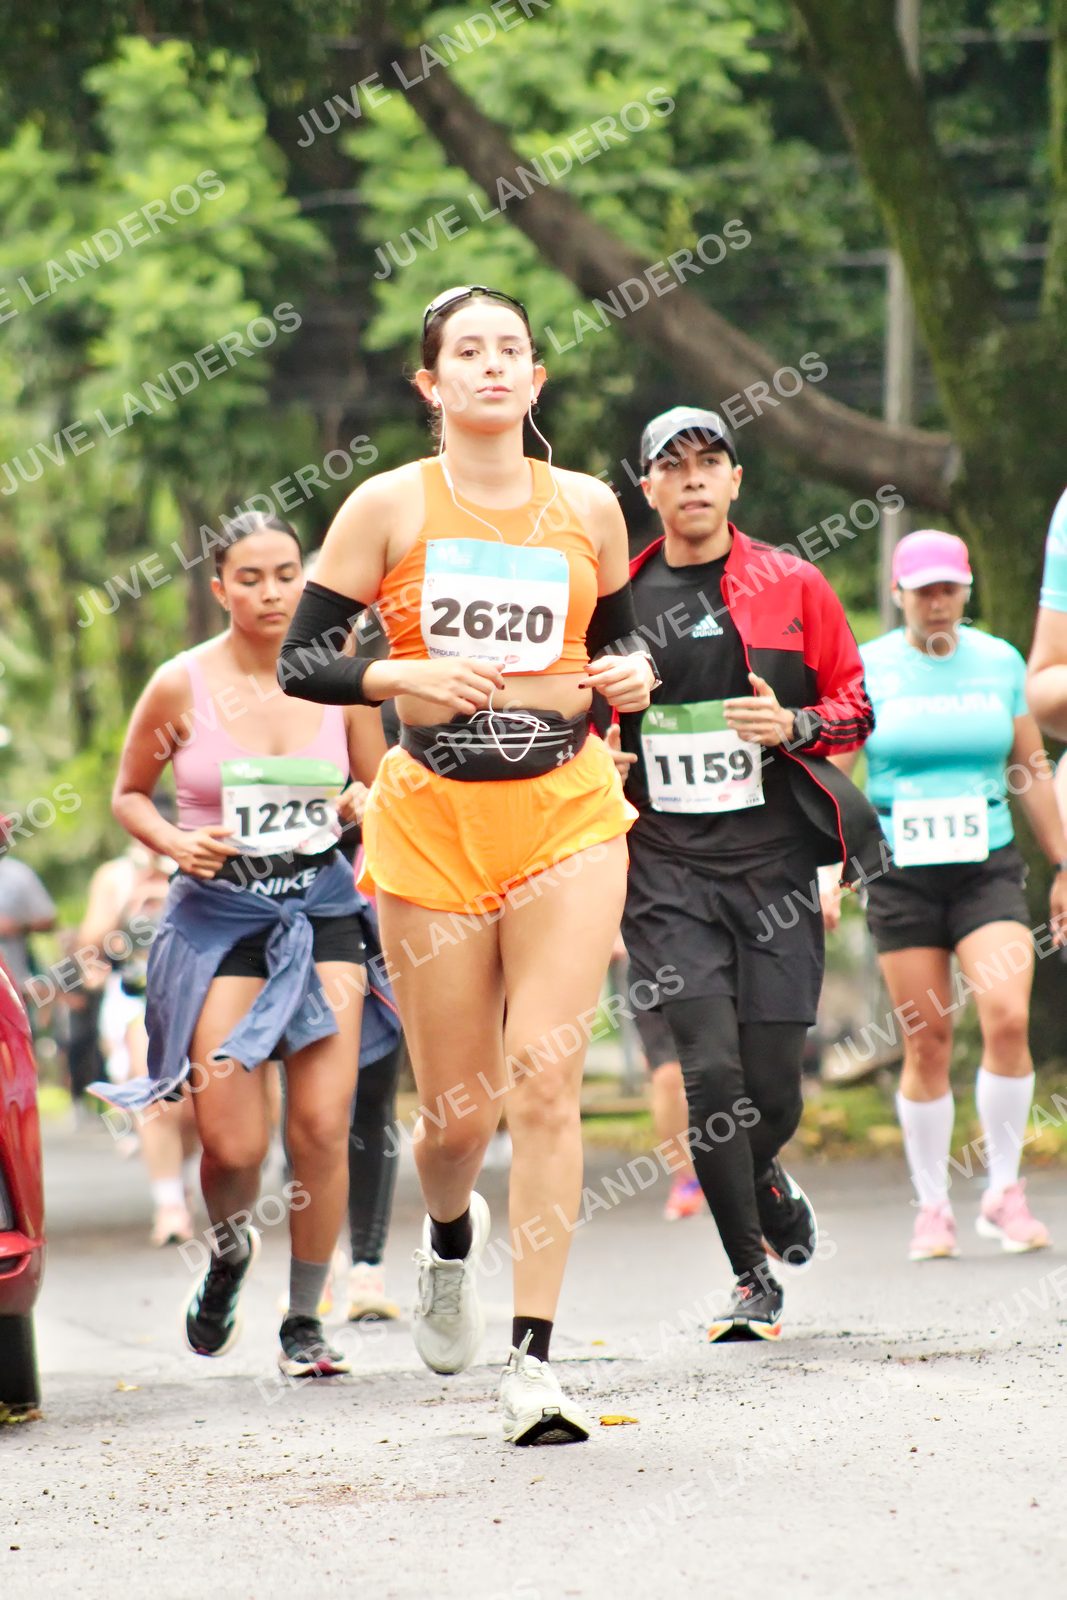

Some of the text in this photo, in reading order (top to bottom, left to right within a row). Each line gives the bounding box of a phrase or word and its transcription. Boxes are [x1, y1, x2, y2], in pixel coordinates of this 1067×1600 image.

[430, 597, 554, 644] 2620
[654, 749, 754, 786] 1159
[235, 798, 328, 838] 1226
[902, 813, 981, 842] 5115
[250, 866, 319, 897] NIKE
